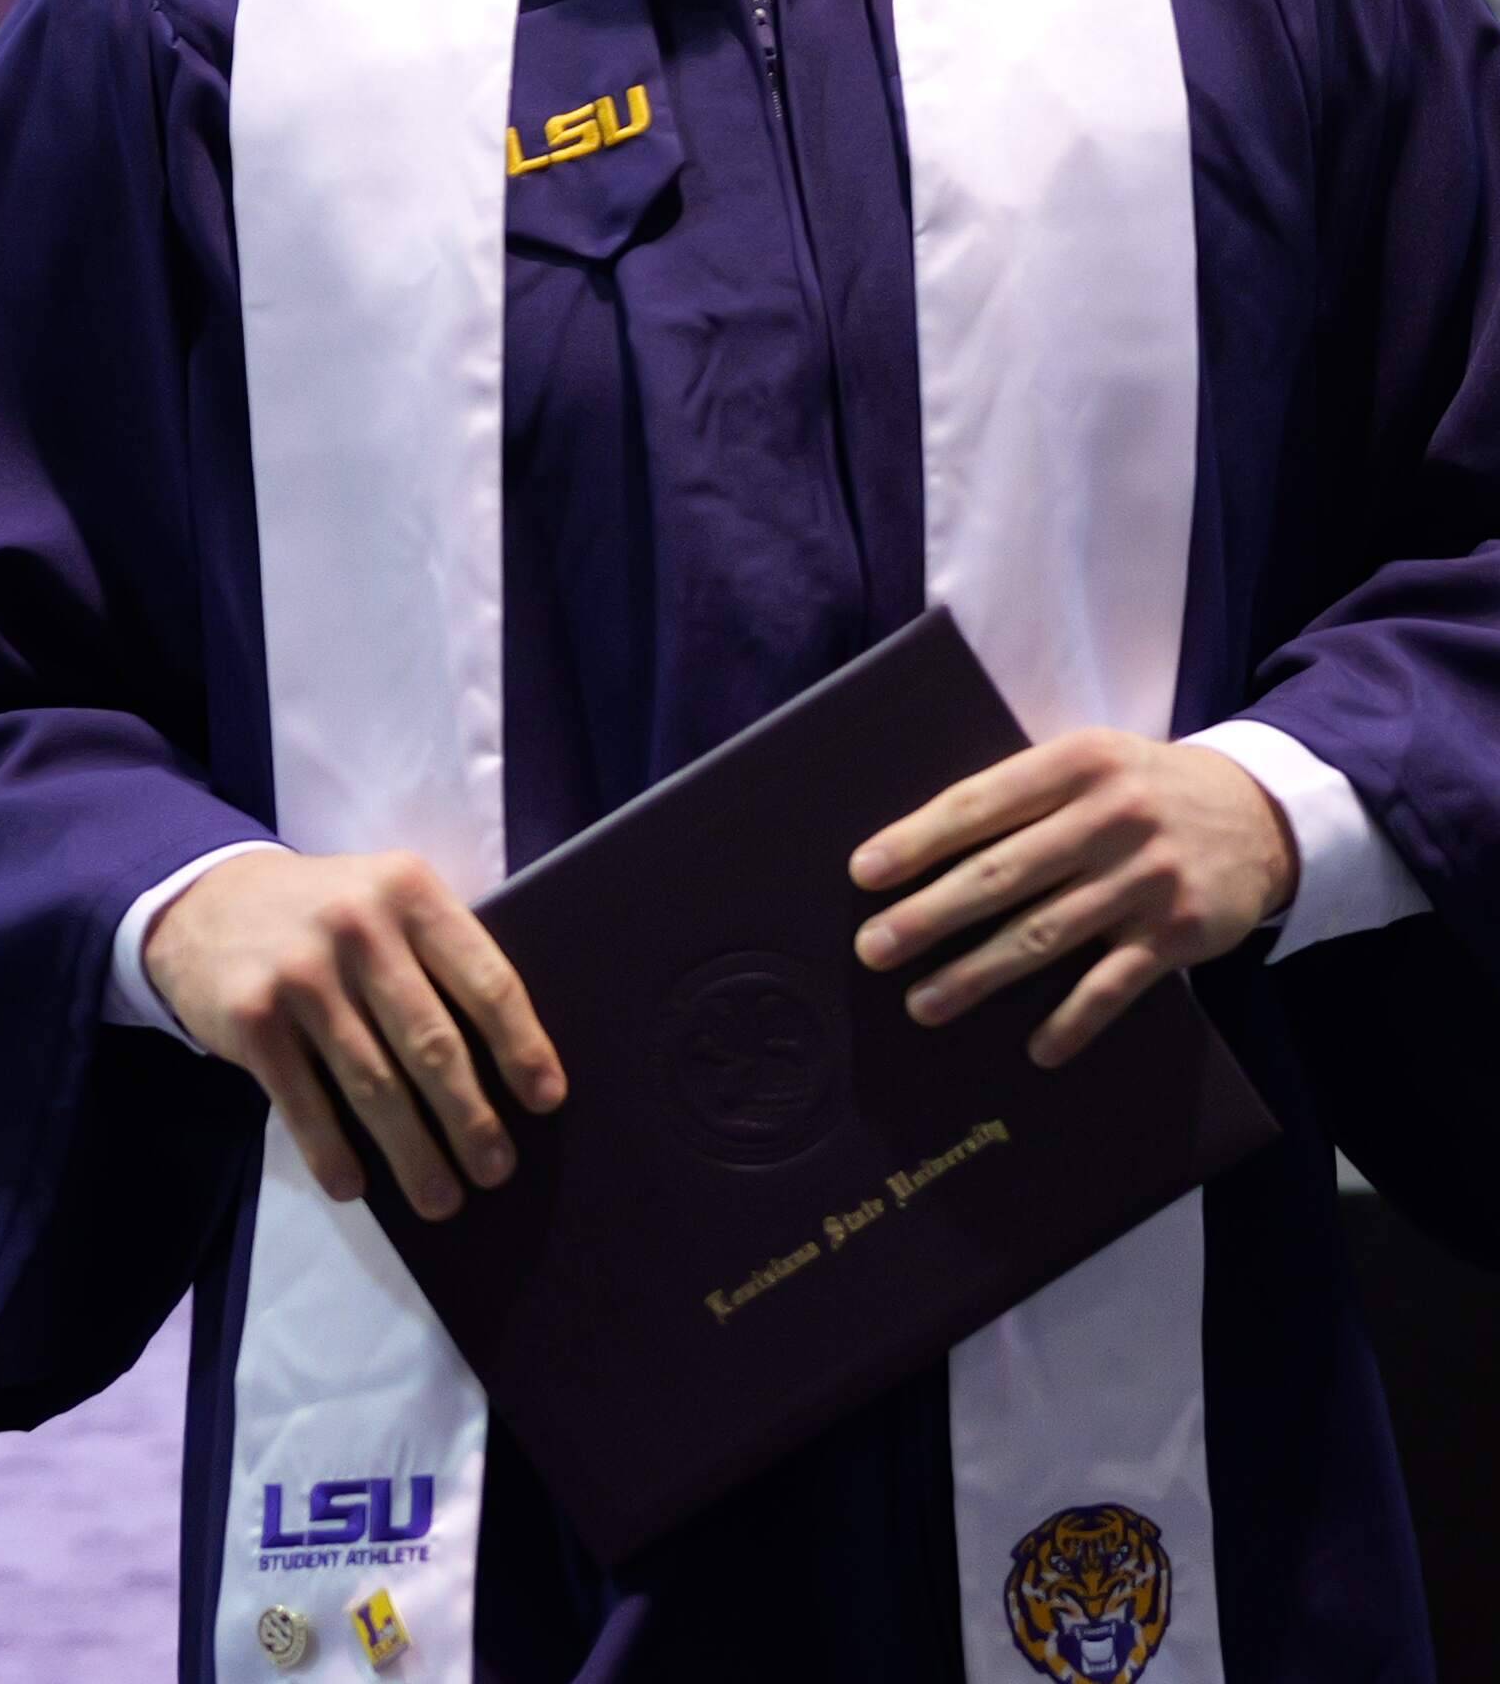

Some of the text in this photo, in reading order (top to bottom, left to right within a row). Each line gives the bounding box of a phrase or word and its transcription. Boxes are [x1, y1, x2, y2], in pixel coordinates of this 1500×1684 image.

[507, 84, 651, 177] LSU
[260, 1474, 434, 1549] LSU
[258, 1545, 430, 1572] STUDENT ATHLETE
